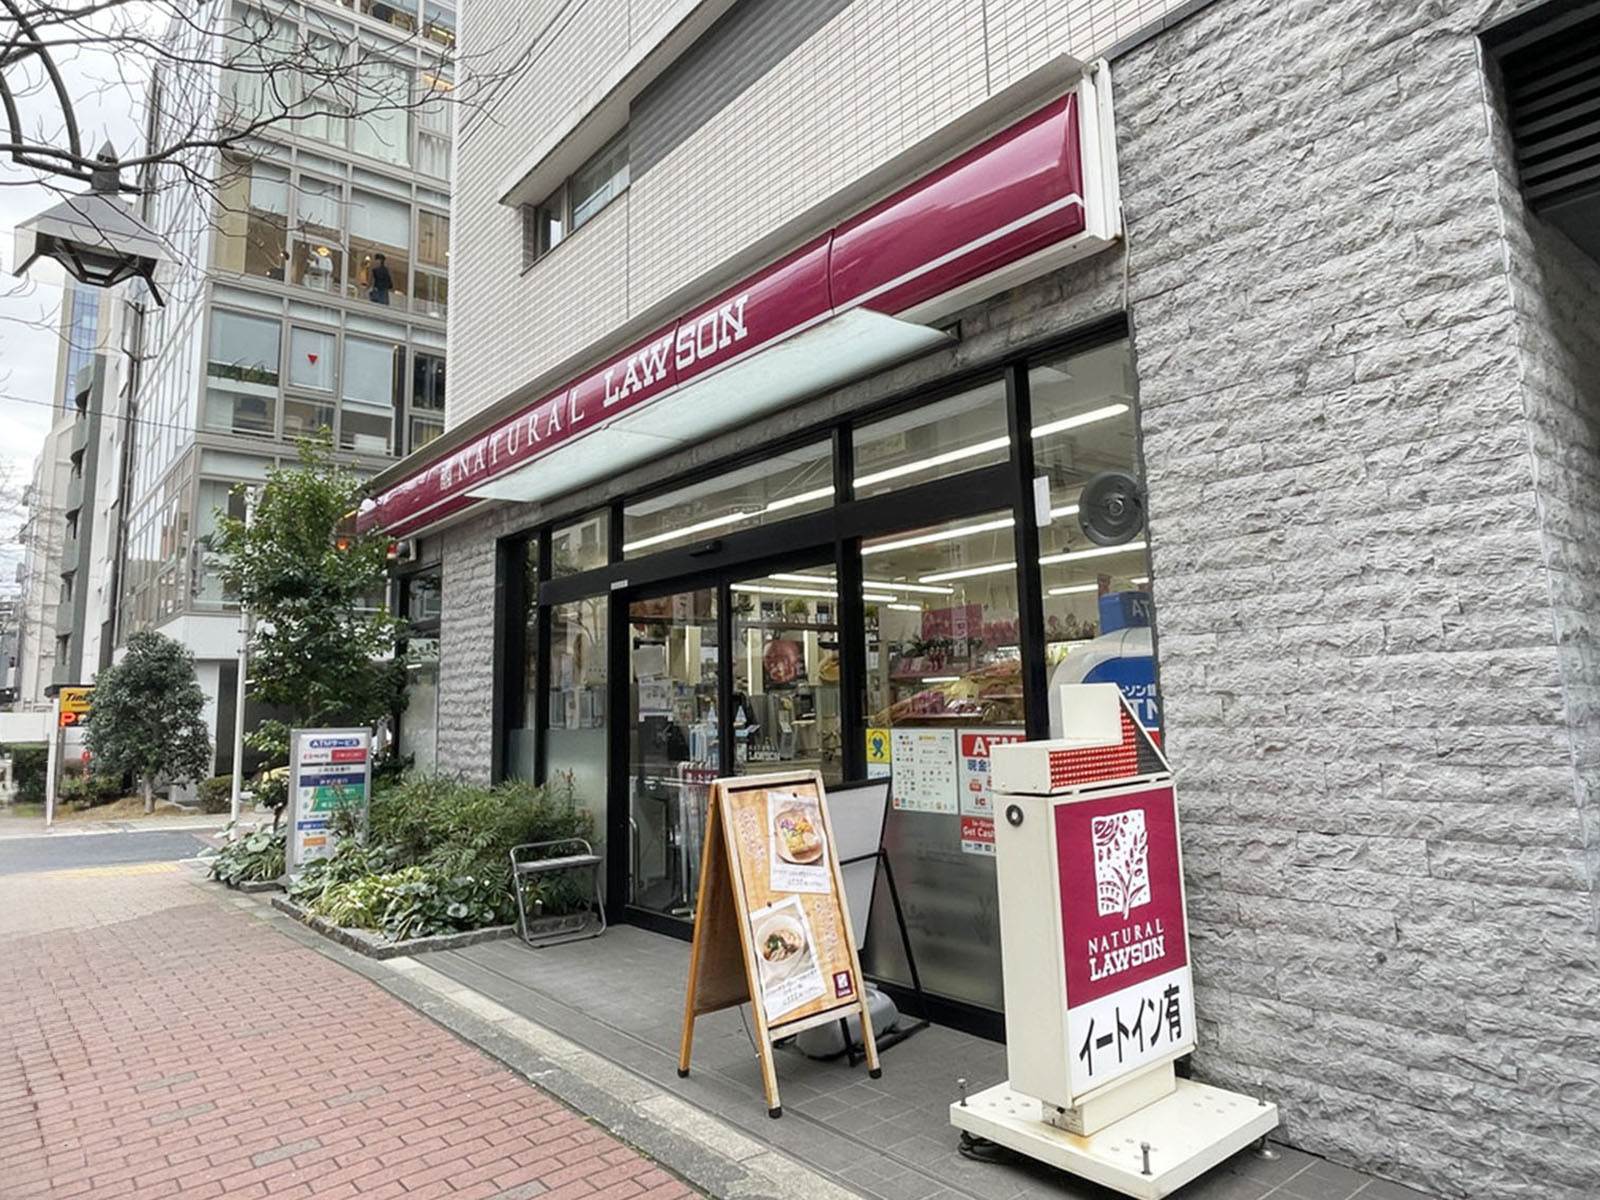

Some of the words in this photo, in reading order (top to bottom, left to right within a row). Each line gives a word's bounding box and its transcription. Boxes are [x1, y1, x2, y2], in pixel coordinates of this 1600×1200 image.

[456, 390, 585, 484] NATURAL
[602, 294, 749, 408] LAWSON
[1087, 918, 1165, 957] NATURAL
[1089, 935, 1166, 982] LAWSON
[1079, 983, 1183, 1077] イートイン有
